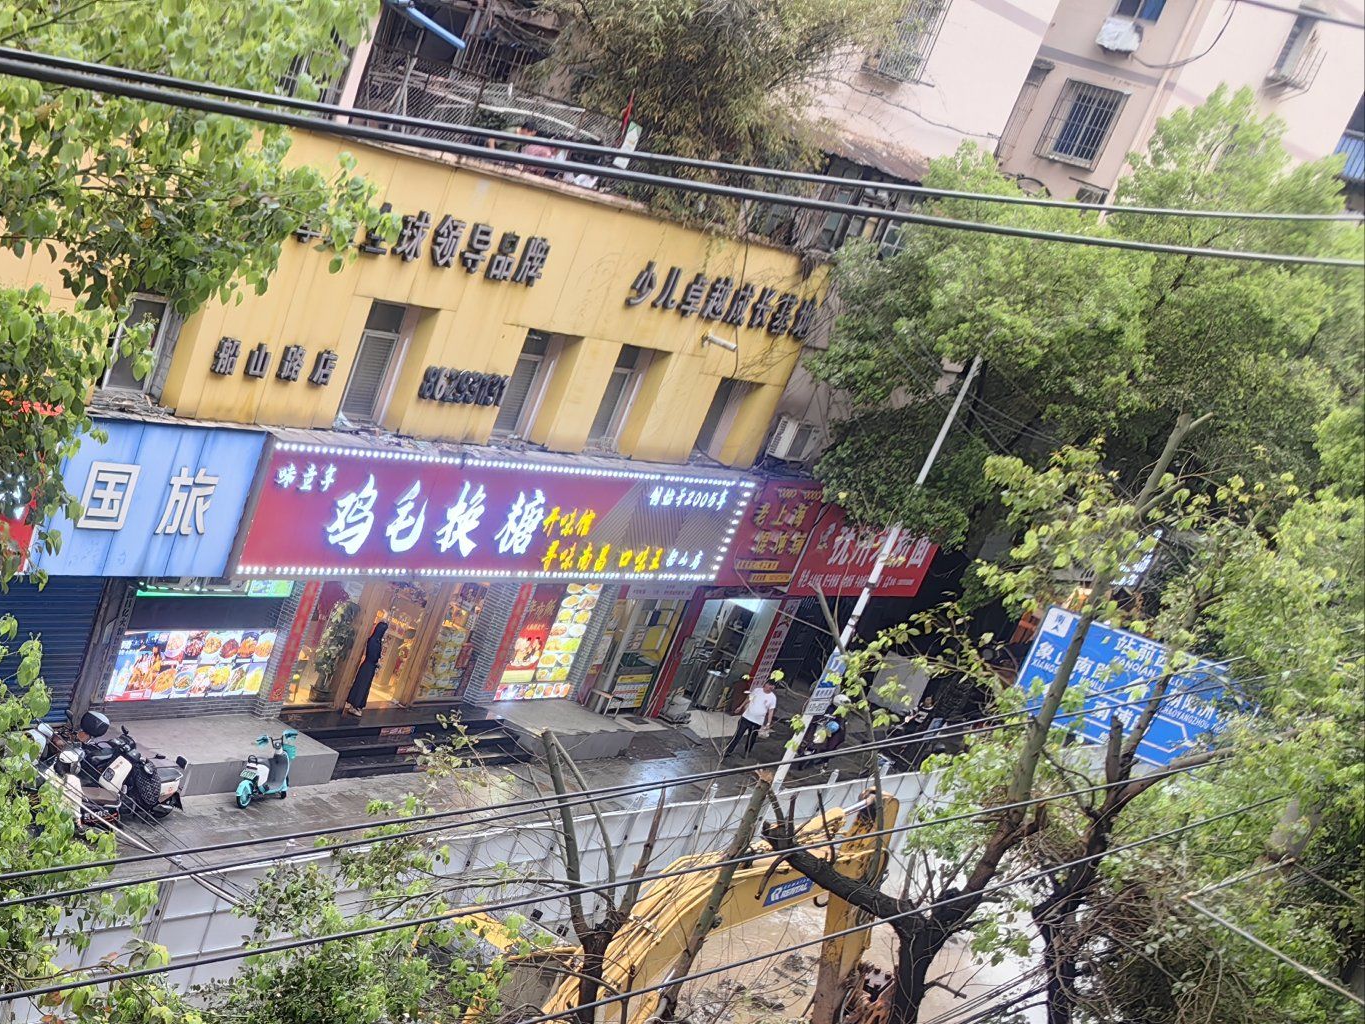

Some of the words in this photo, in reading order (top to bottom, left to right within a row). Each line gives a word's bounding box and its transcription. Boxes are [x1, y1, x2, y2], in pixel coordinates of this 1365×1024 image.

[292, 202, 550, 287] 全球领导品牌
[625, 260, 818, 340] 少儿卓越成长基地
[210, 336, 338, 386] 船山路店
[76, 461, 219, 535] 国旅
[326, 473, 546, 557] 鸡毛换糖
